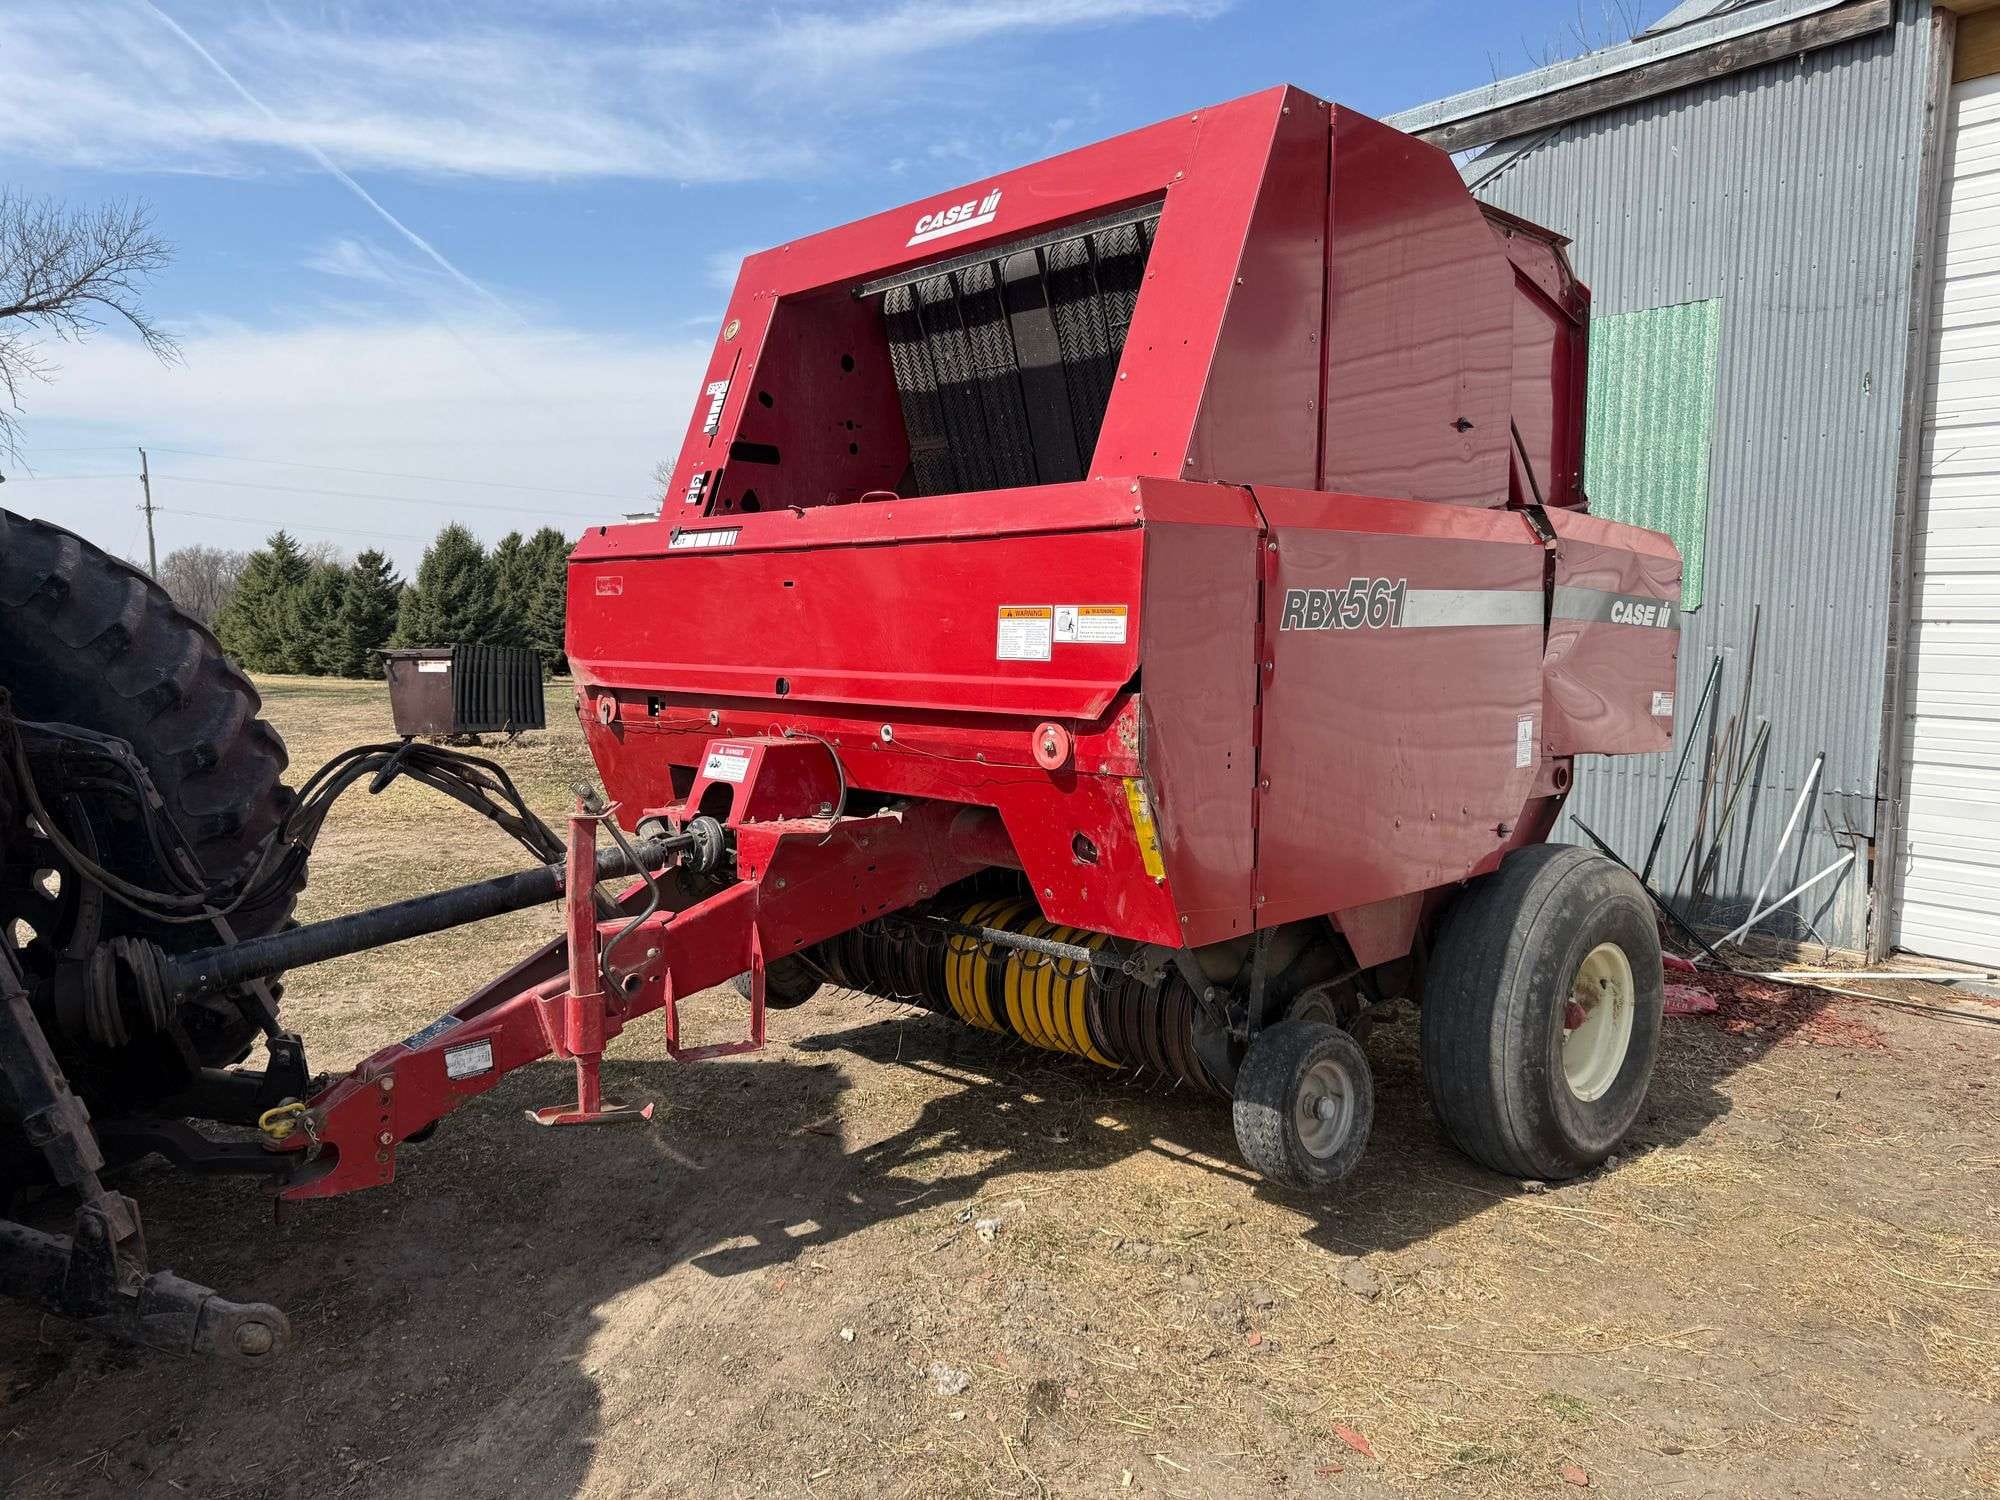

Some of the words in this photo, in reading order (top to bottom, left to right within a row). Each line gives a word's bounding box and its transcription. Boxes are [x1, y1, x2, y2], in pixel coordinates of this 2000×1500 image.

[914, 199, 979, 235] CASE
[1015, 609, 1043, 617] WARNING
[1280, 577, 1407, 631] RBX561
[1610, 600, 1657, 626] CASE
